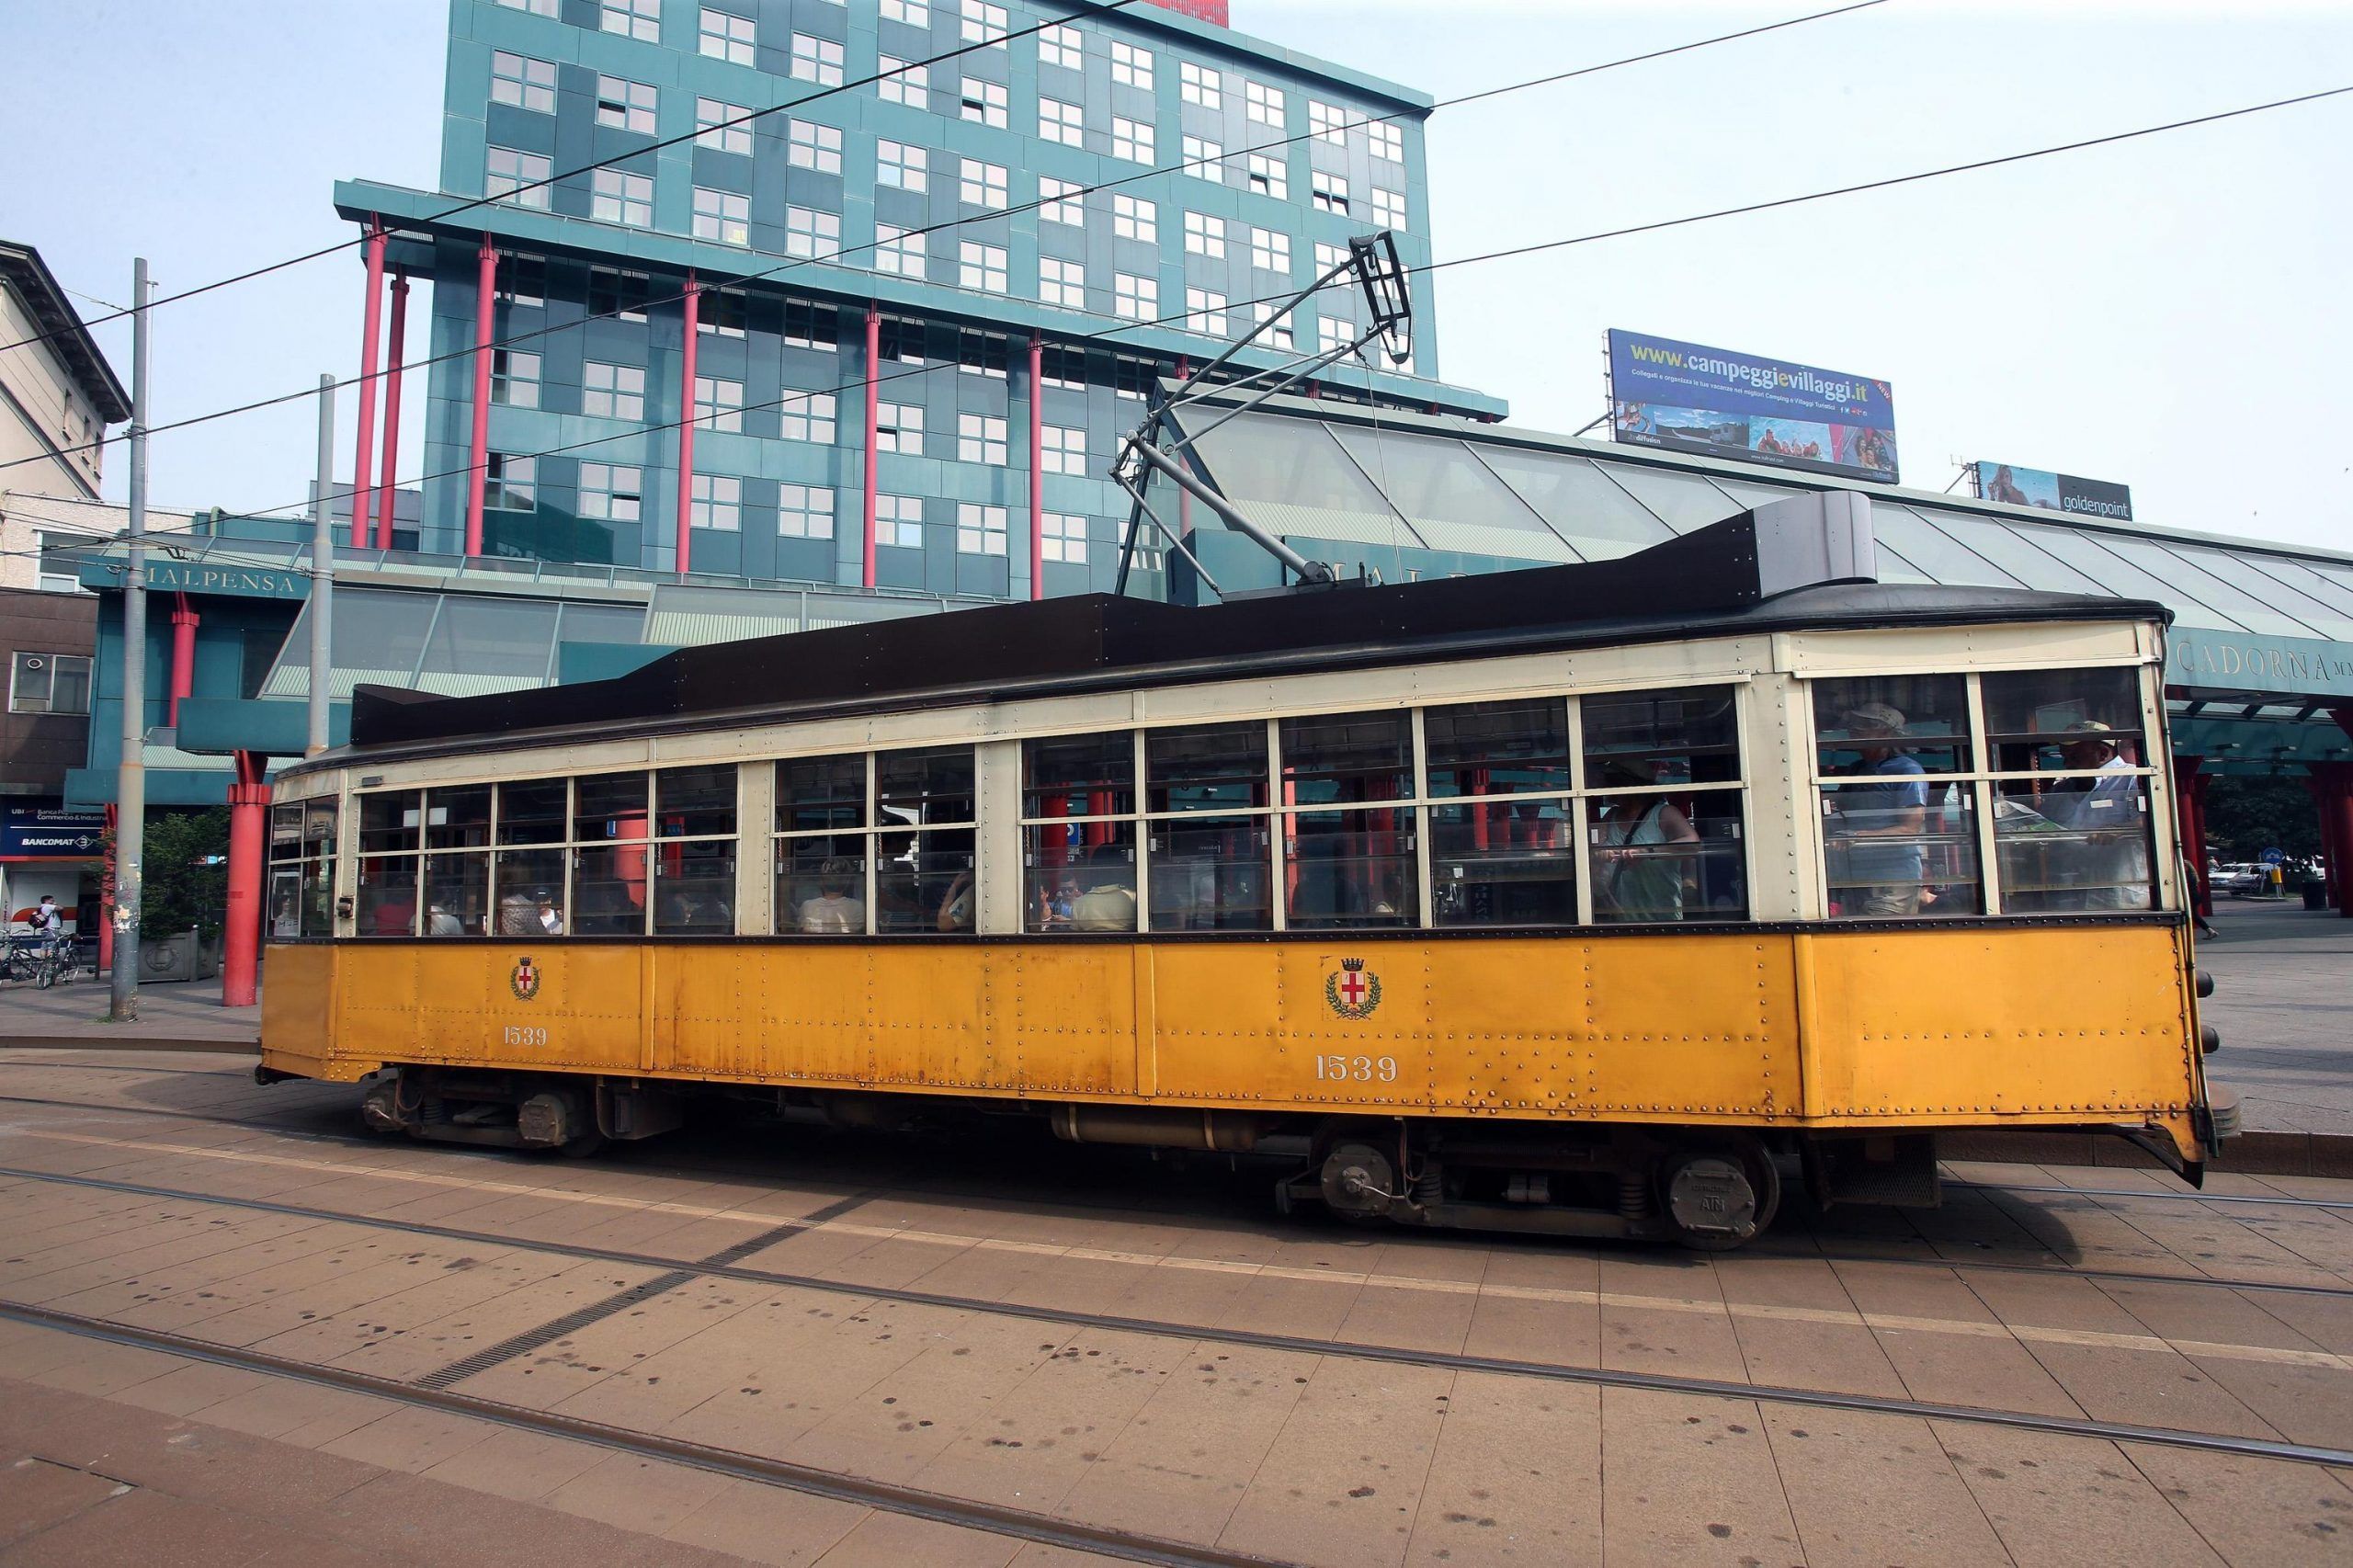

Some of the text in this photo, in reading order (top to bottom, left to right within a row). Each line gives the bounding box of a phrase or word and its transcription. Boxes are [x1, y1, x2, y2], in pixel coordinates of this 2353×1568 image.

[1630, 344, 1869, 403] www.campeggievillaggi.it
[1631, 369, 1658, 379] Collegati
[1665, 375, 1693, 385] organizza
[1765, 392, 1790, 404] Camping
[1876, 381, 1891, 400] NEW
[2063, 494, 2130, 517] goldenpoint
[2177, 641, 2331, 681] CADORNA
[504, 1026, 548, 1046] 1539
[1316, 1055, 1398, 1082] 1539
